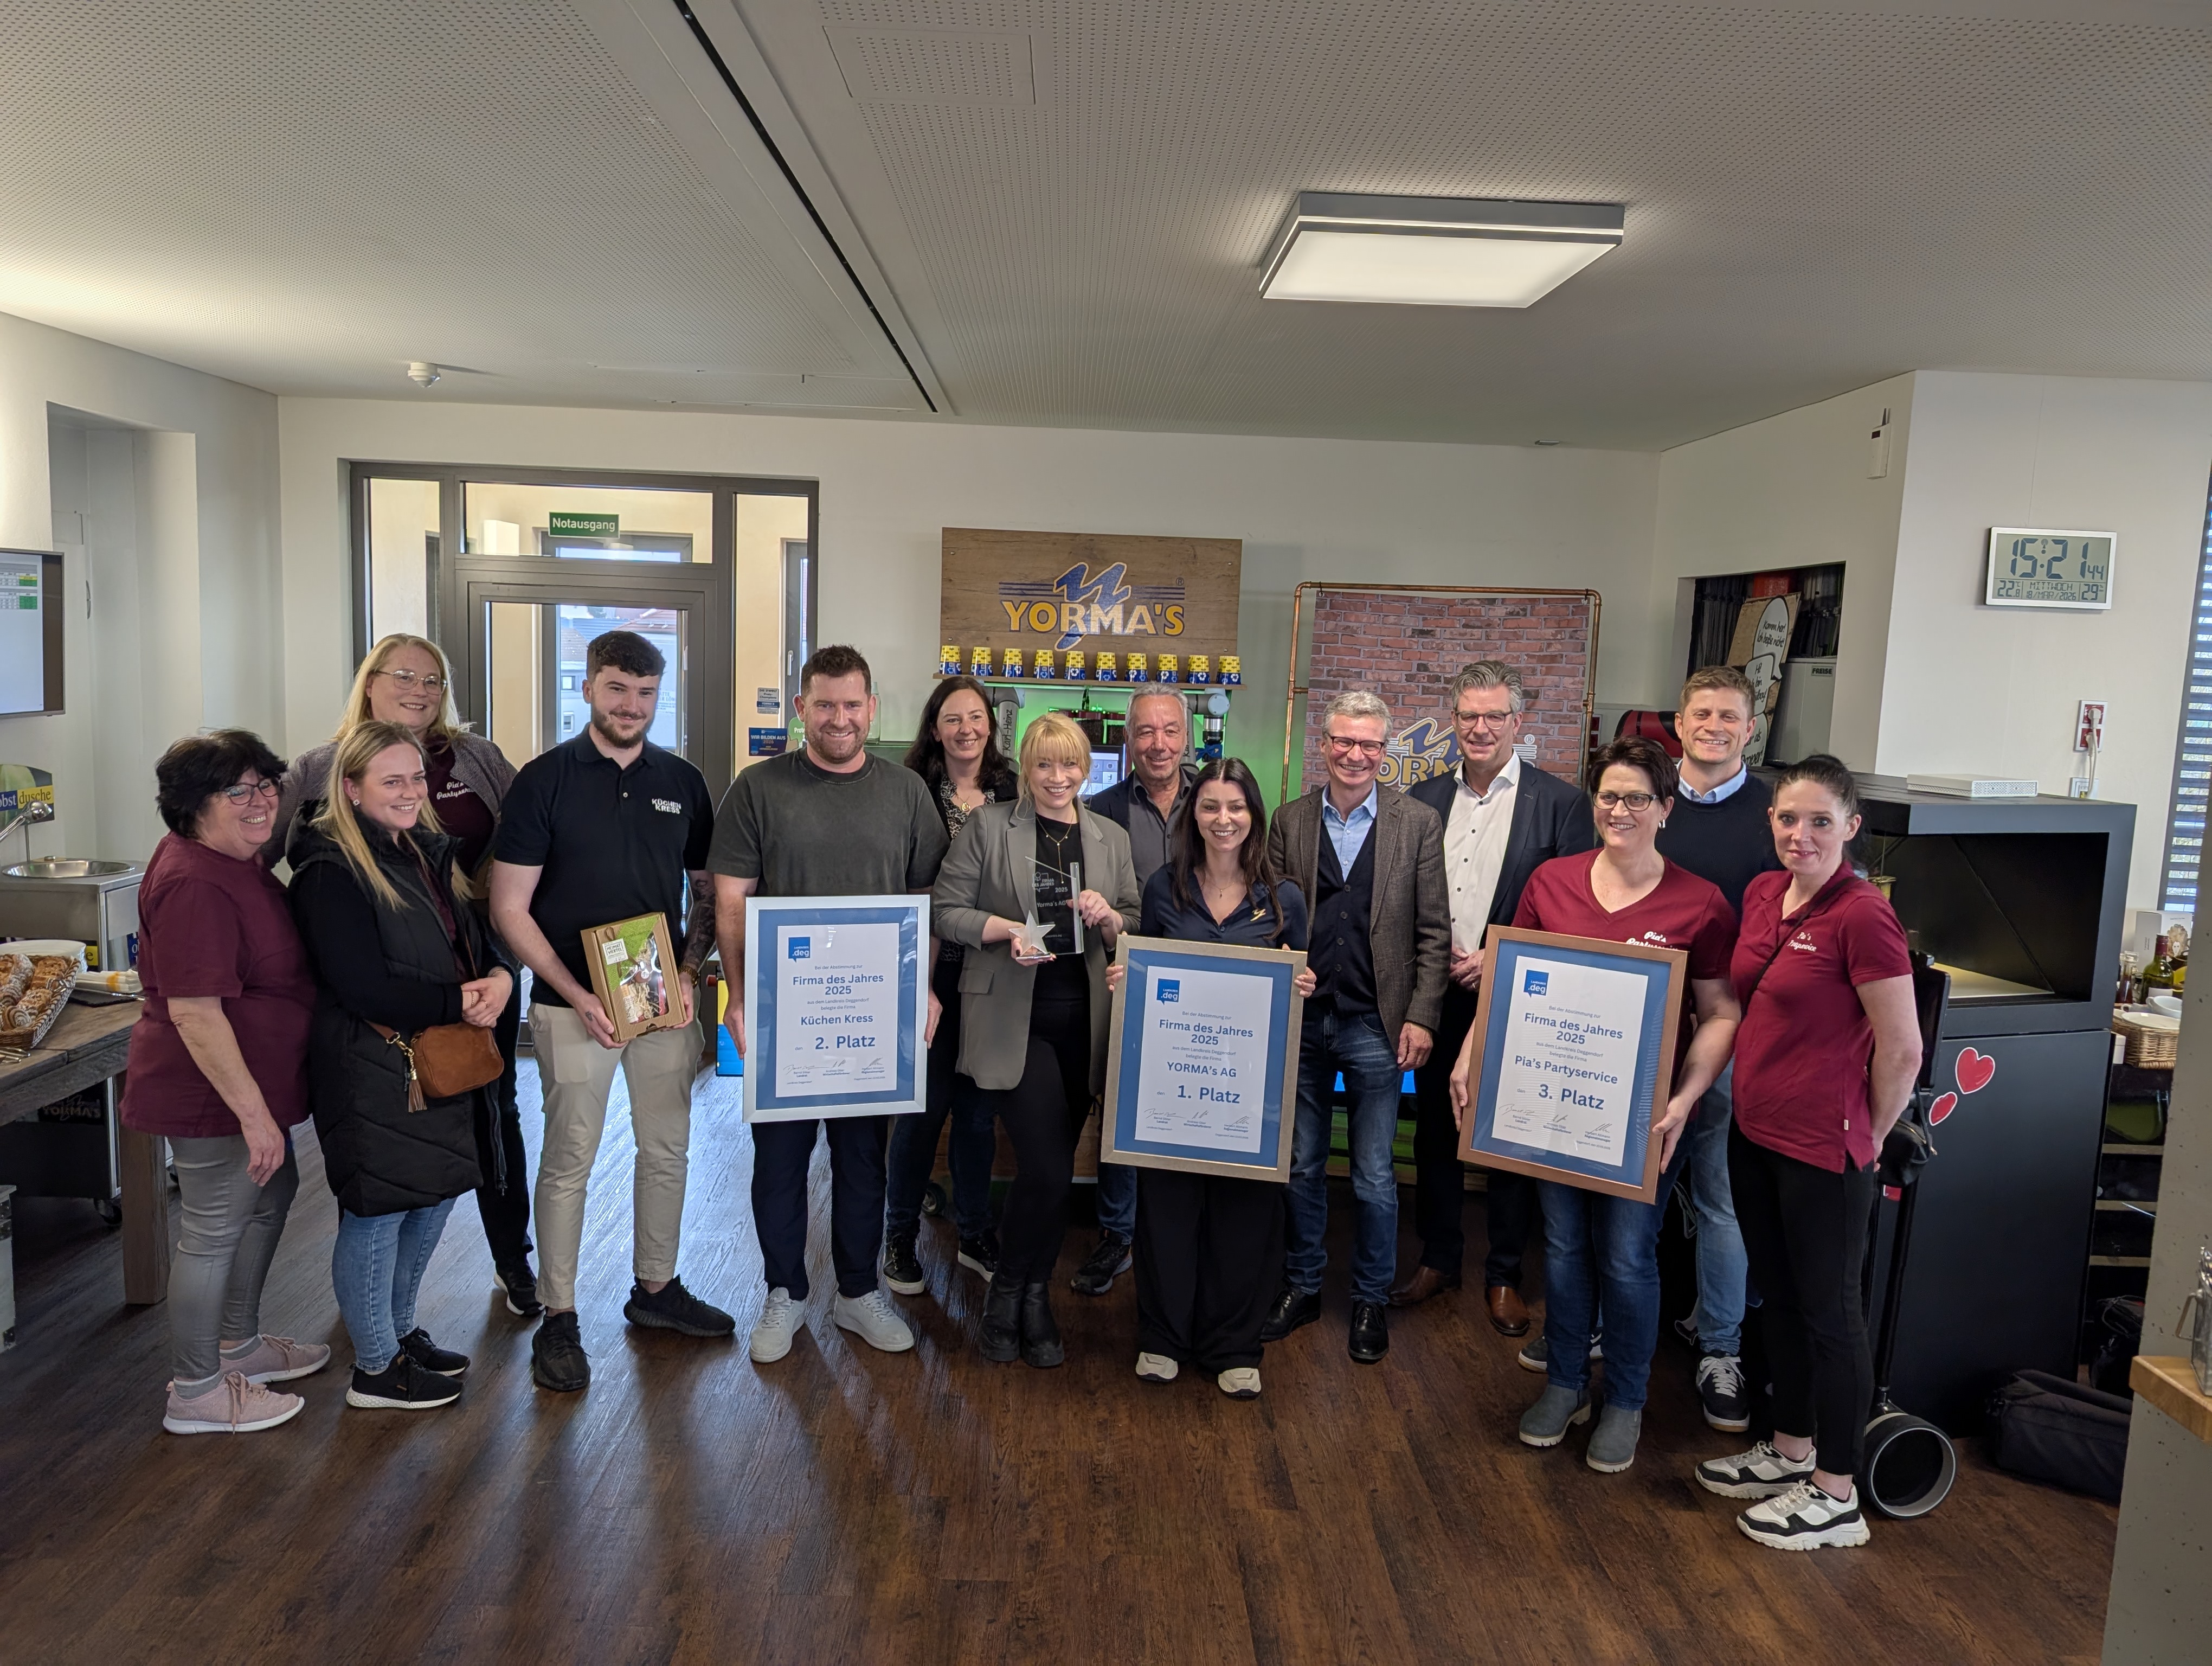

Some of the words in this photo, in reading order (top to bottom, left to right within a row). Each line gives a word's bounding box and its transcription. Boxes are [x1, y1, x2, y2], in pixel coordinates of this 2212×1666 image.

[552, 517, 616, 533] Notausgang
[2010, 537, 2089, 579] 15:21
[2087, 565, 2104, 580] 44
[2029, 582, 2073, 591] MITTWOCH
[1000, 599, 1186, 637] YORMA'S
[651, 798, 681, 810] KÜCHEN
[1643, 931, 1667, 943] Pia's
[793, 976, 824, 985] Firma
[826, 975, 846, 984] des
[848, 973, 884, 983] Jahres
[825, 985, 852, 995] 2025
[801, 1015, 841, 1026] Küchen
[844, 1014, 874, 1024] Kress
[1524, 1013, 1557, 1028] Firma
[1559, 1018, 1580, 1031] des
[1582, 1023, 1623, 1039] Jahres
[1159, 1019, 1191, 1031] Firma
[1193, 1022, 1213, 1034] des
[1216, 1025, 1253, 1037] Jahres
[815, 1036, 829, 1050] 2.
[836, 1035, 876, 1049] Platz
[1191, 1034, 1219, 1046] 2025
[1556, 1030, 1586, 1045] 2025
[1166, 1061, 1218, 1076] YORMA's
[1220, 1067, 1237, 1078] AG
[1514, 1054, 1541, 1069] Pia's
[1544, 1060, 1618, 1084] Partyservice
[1177, 1085, 1192, 1099] 1.
[1199, 1086, 1241, 1104] Platz
[1538, 1084, 1553, 1100] 3.
[1560, 1087, 1605, 1110] Platz
